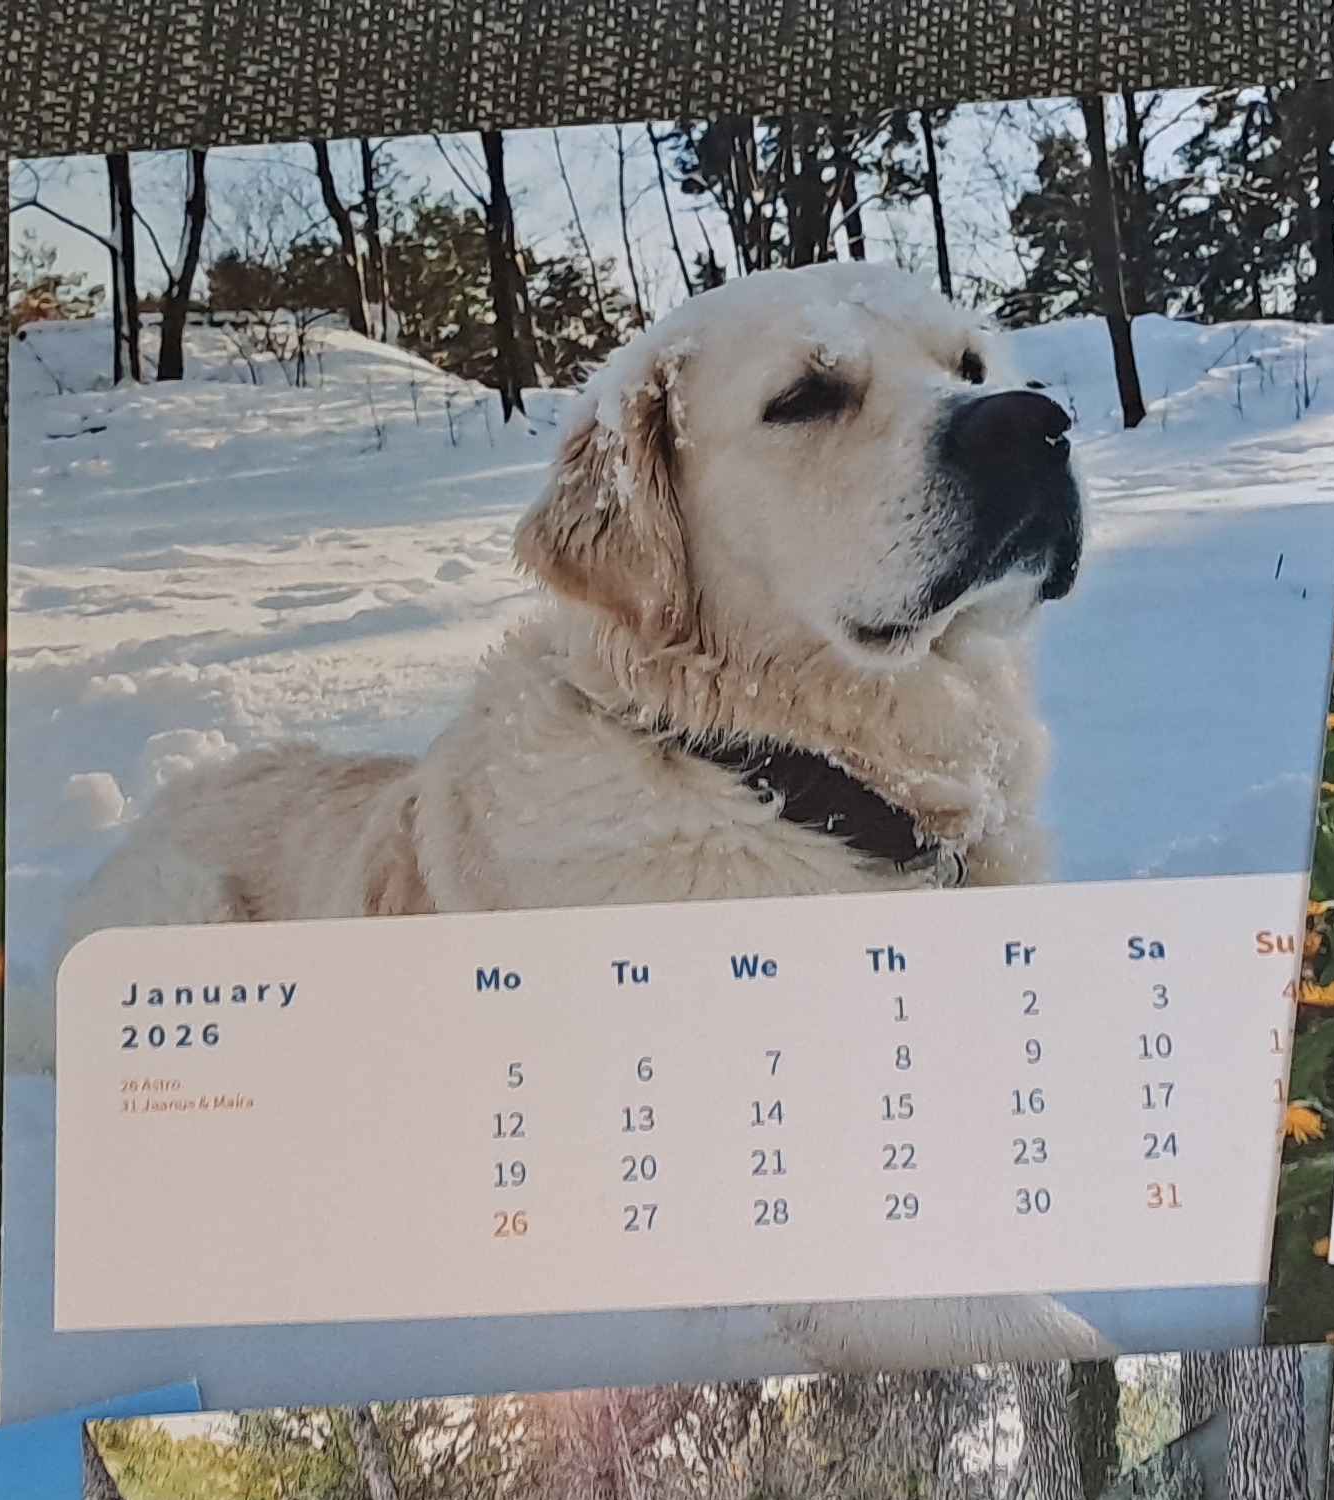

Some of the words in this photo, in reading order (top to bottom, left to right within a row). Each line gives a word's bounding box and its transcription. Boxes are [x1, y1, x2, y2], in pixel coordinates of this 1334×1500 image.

[477, 967, 521, 992] Mo
[611, 961, 648, 984] Tu
[731, 954, 777, 979] We
[866, 946, 905, 973] Th
[1005, 942, 1036, 966] Fr
[1128, 937, 1165, 959] Sa
[1255, 930, 1296, 955] Su
[122, 983, 296, 1007] January
[895, 996, 909, 1022] 1
[1022, 989, 1039, 1016] 2
[1152, 983, 1169, 1010] 3
[122, 1024, 219, 1049] 2026
[508, 1062, 524, 1089] 5
[637, 1056, 654, 1082] 6
[765, 1050, 781, 1076] 7
[895, 1044, 912, 1071] 8
[1025, 1038, 1042, 1065] 9
[1139, 1033, 1172, 1060] 10
[493, 1111, 526, 1139] 12
[622, 1105, 655, 1133] 13
[751, 1099, 783, 1127] 14
[882, 1092, 914, 1121] 15
[1012, 1087, 1045, 1114] 16
[1142, 1082, 1174, 1110] 17
[494, 1160, 526, 1188] 19
[621, 1154, 657, 1182] 20
[751, 1148, 787, 1176] 21
[882, 1143, 917, 1170] 22
[1012, 1137, 1048, 1165] 23
[1143, 1131, 1177, 1159] 24
[493, 1209, 528, 1238] 26
[623, 1203, 658, 1232] 27
[753, 1198, 789, 1226] 28
[885, 1192, 919, 1221] 29
[1016, 1187, 1051, 1215] 30
[1146, 1182, 1183, 1209] 31
